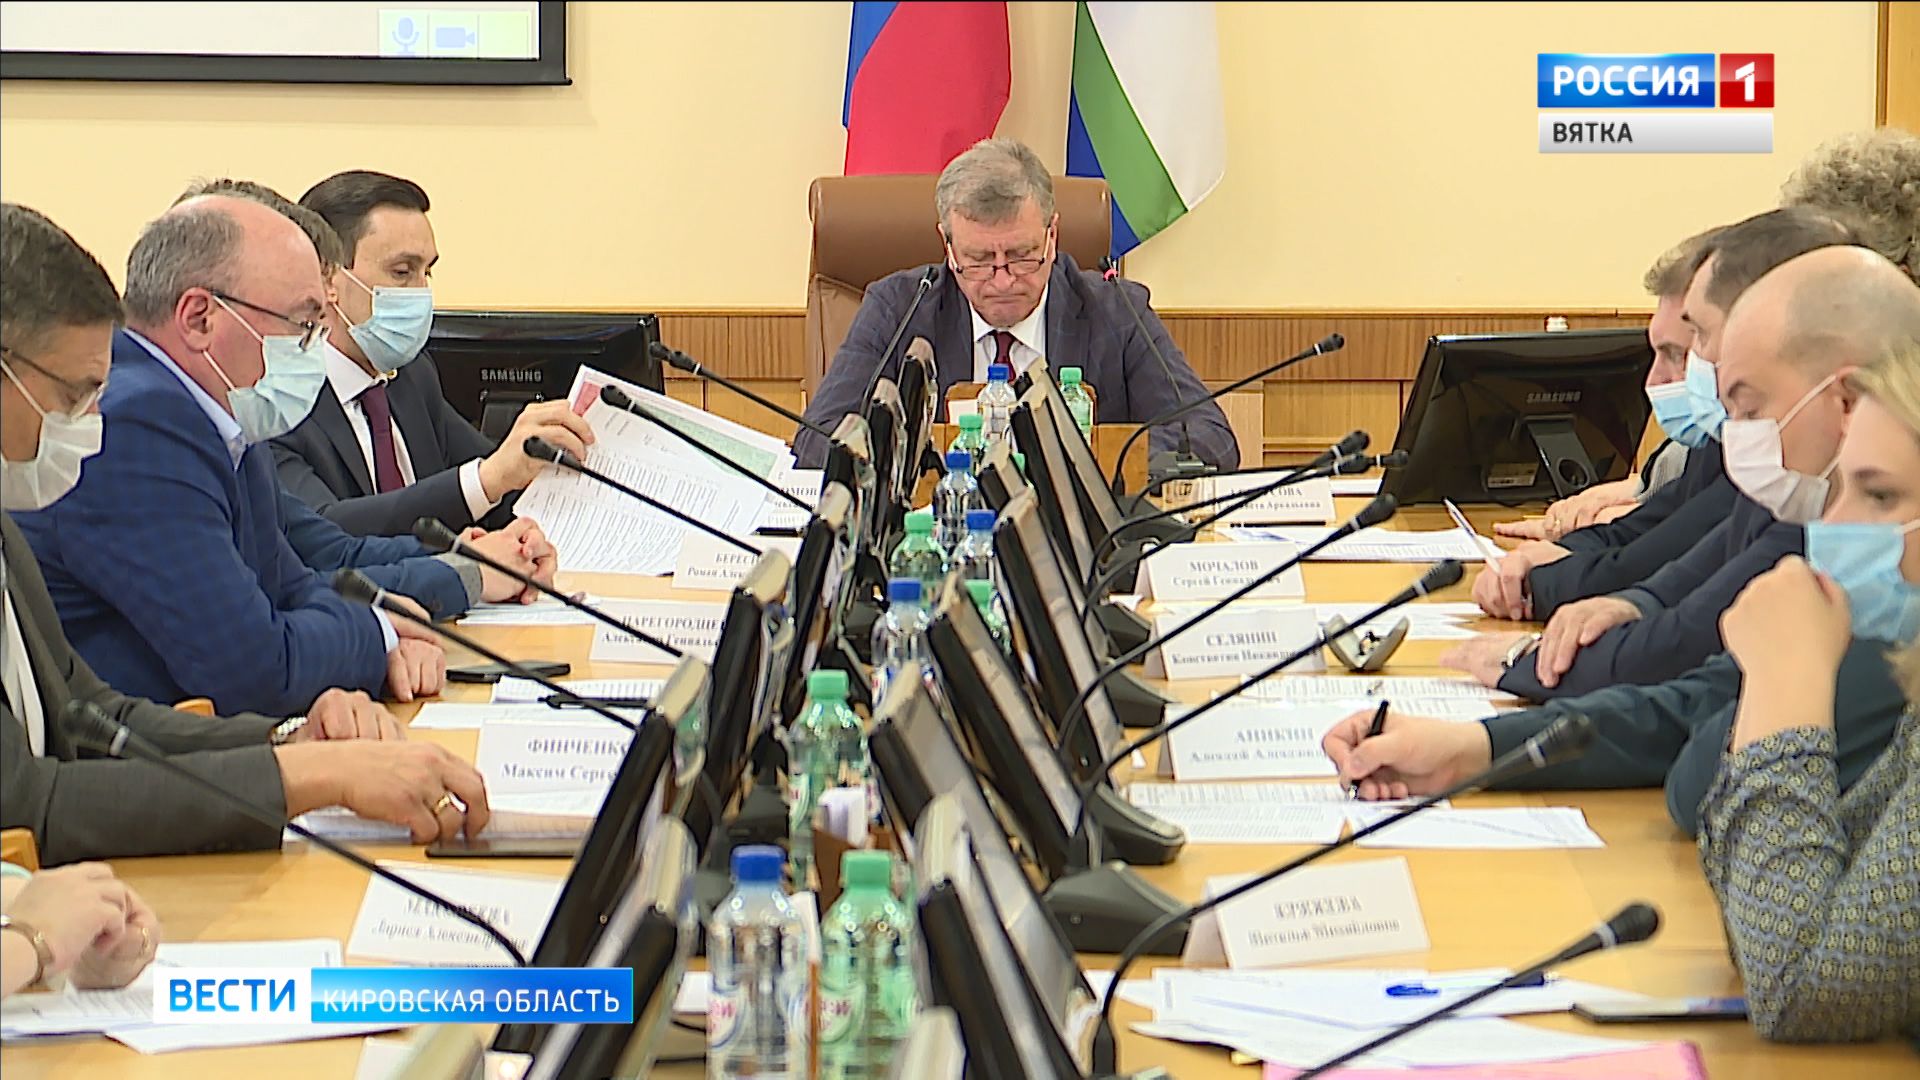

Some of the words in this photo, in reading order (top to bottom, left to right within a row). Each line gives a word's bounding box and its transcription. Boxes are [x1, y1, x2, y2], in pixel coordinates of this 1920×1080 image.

[480, 368, 542, 383] SAMSUNG
[1526, 391, 1581, 404] SAMSUNG
[1189, 560, 1259, 572] МОЧАЛОВ
[1172, 575, 1212, 588] Сергей
[1205, 631, 1278, 647] СЕЛЯНИН
[1235, 727, 1314, 743] АНИКИН
[502, 763, 566, 779] Максим
